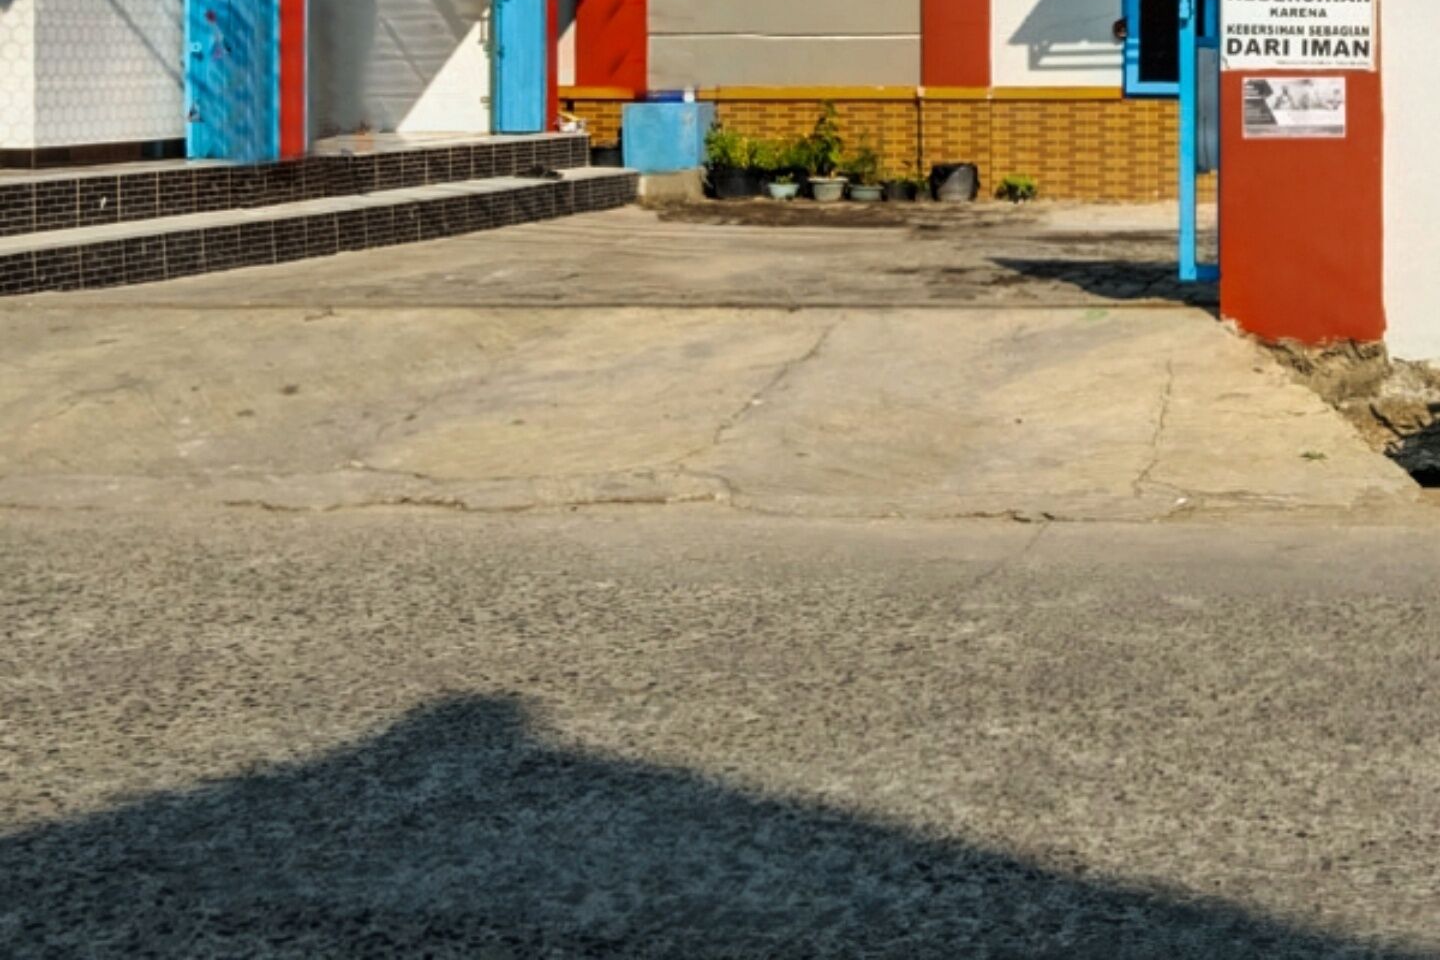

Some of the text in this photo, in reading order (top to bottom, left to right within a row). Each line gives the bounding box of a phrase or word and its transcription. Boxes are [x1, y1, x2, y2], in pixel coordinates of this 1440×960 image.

[1269, 7, 1328, 18] KARENA
[1226, 24, 1370, 37] KEBERSIHAN SEBAGIAN
[1226, 38, 1370, 58] DARI IMAN
